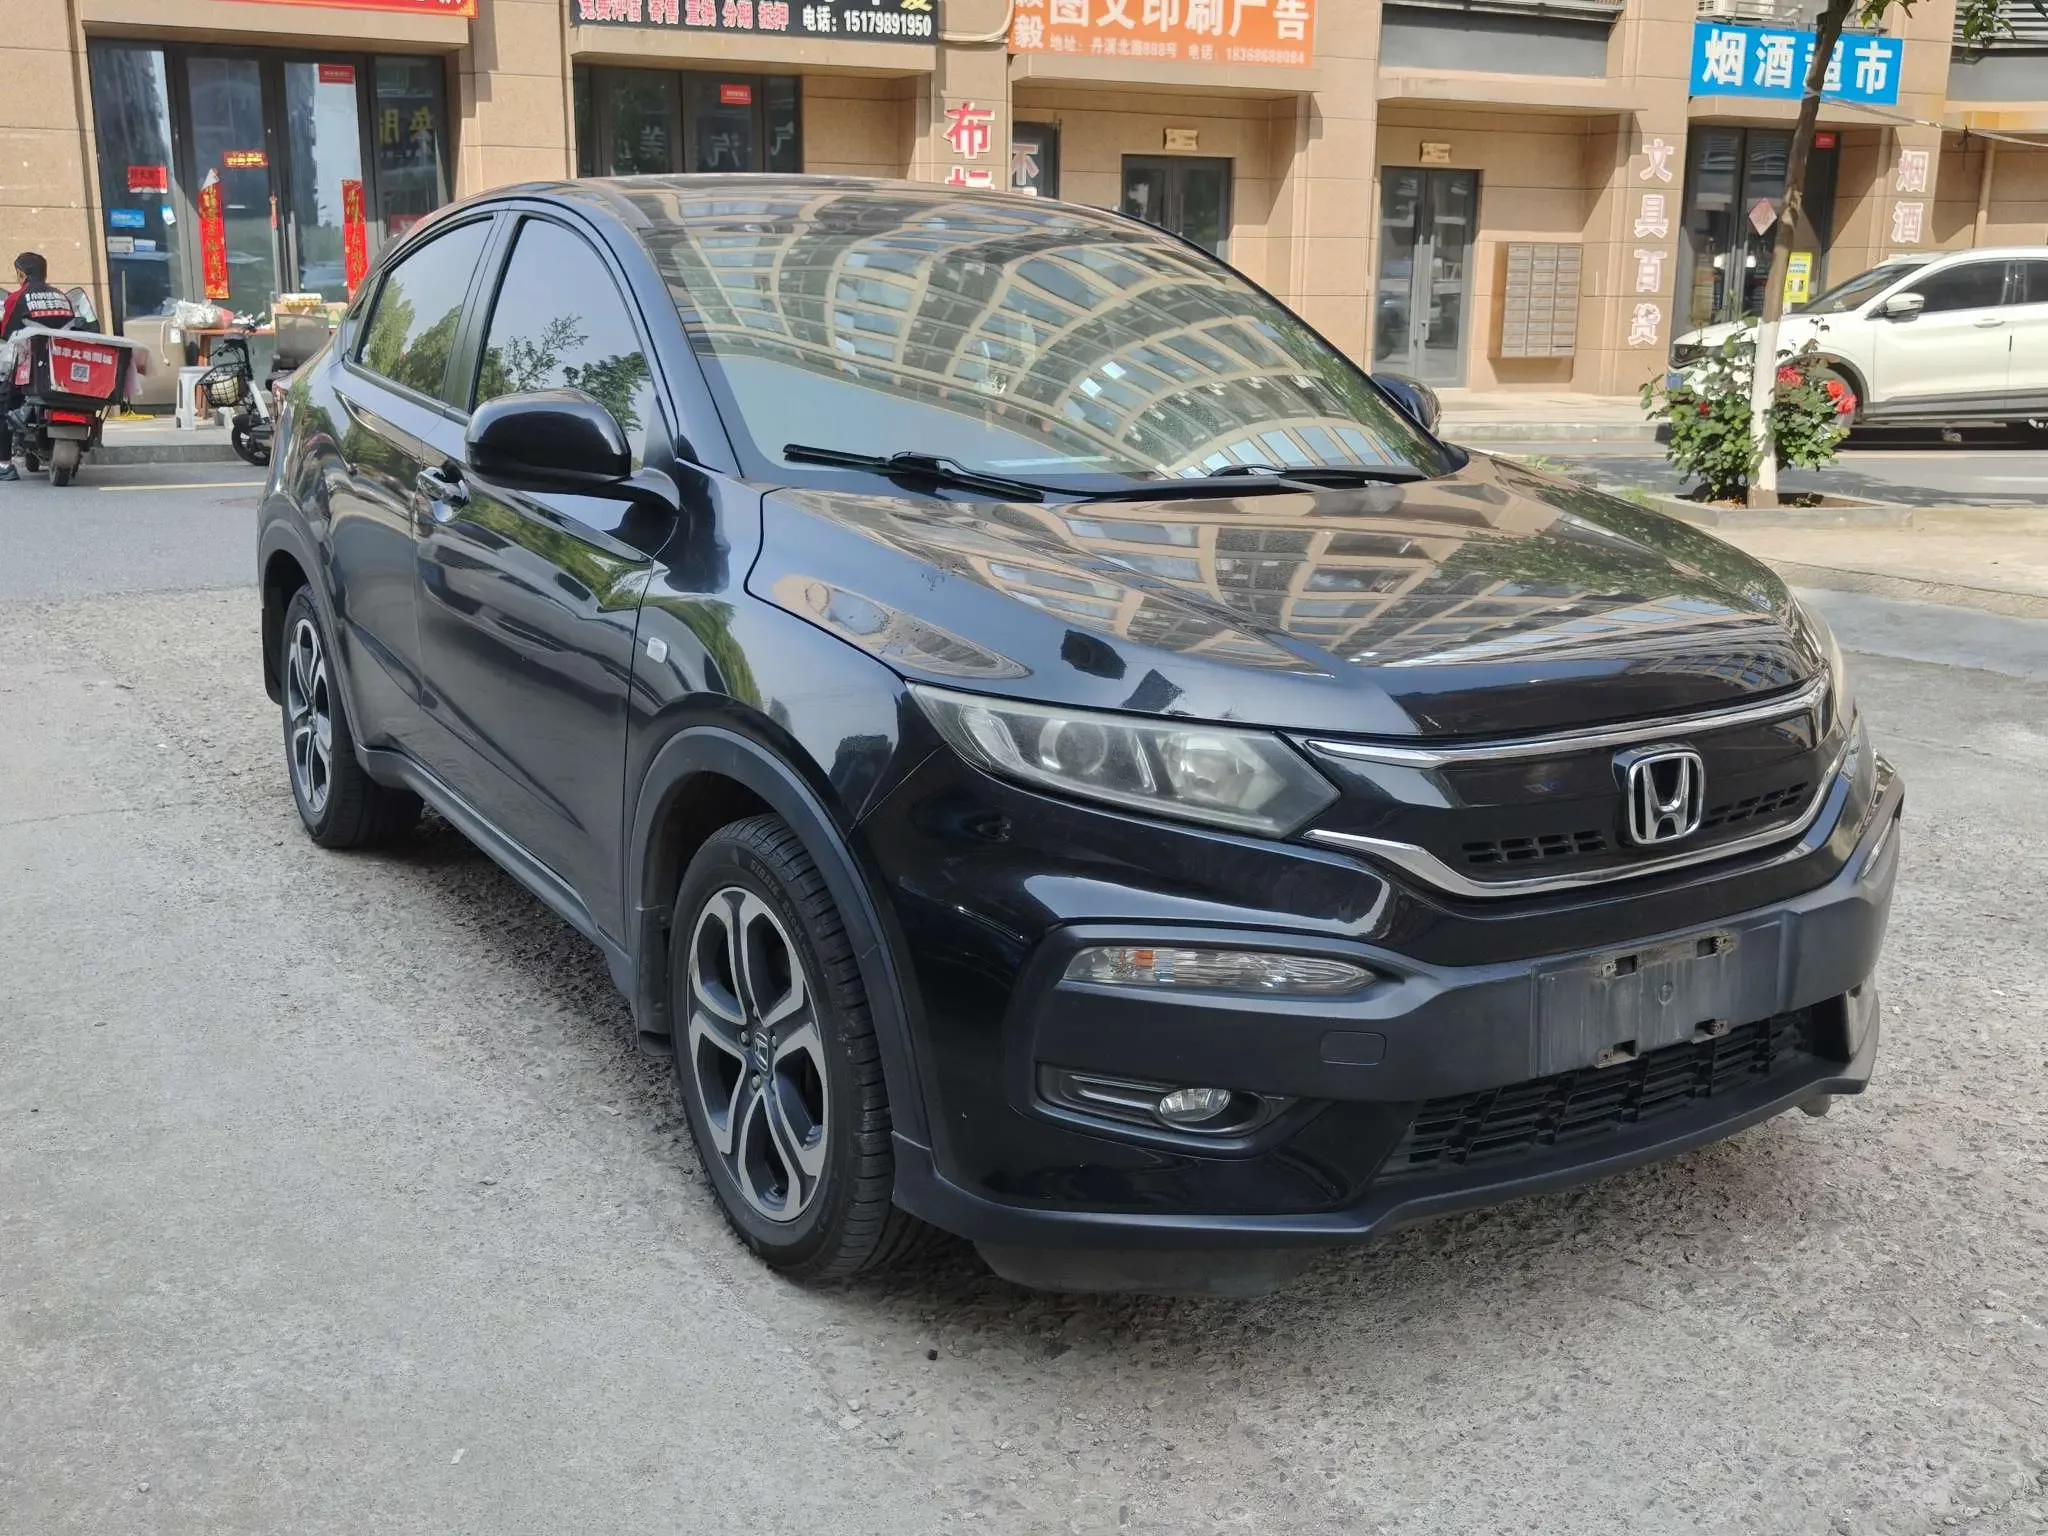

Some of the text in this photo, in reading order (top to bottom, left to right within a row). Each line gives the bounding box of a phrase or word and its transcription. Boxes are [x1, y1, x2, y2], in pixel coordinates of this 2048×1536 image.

[1050, 0, 1310, 41] 图文印刷广告
[1701, 28, 1893, 95] 烟酒超市
[1627, 138, 1676, 346] 文具百货
